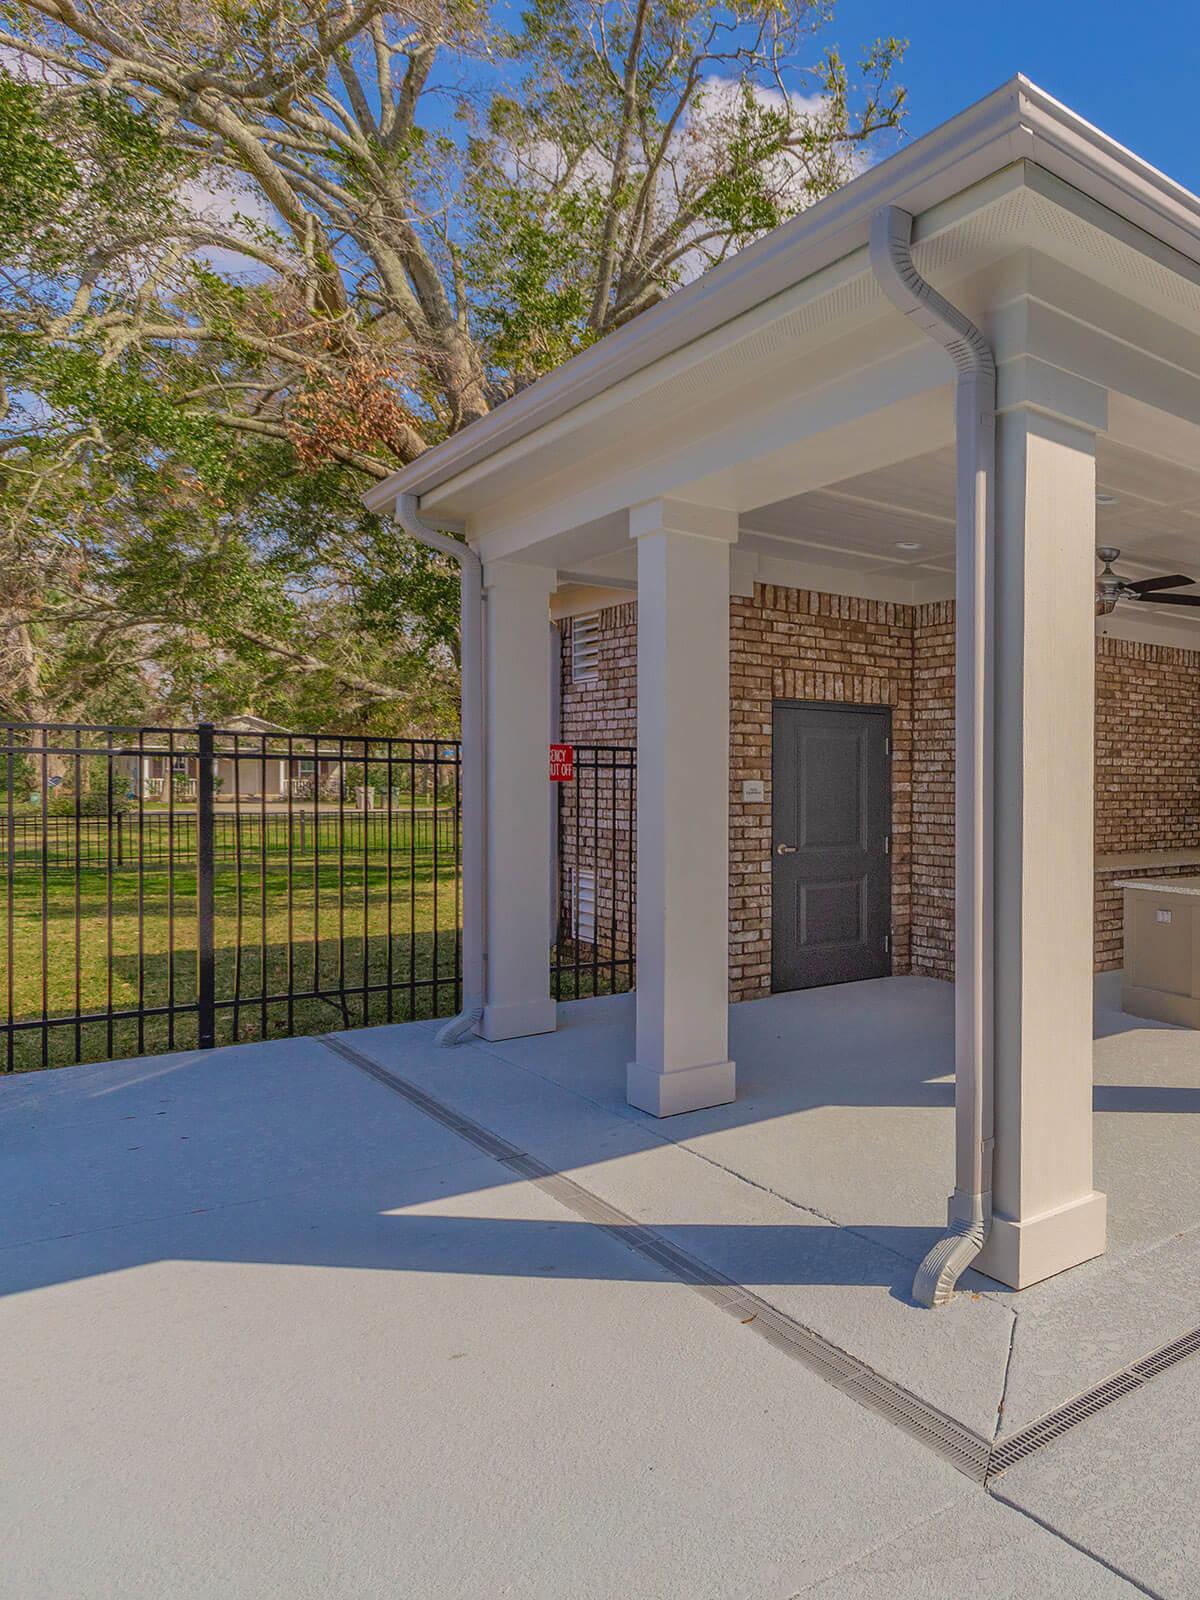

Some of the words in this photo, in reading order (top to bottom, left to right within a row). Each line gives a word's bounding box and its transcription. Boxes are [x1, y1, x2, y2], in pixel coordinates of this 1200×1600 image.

[550, 749, 566, 762] ENCY
[550, 763, 560, 776] UT
[561, 763, 573, 776] OFF
